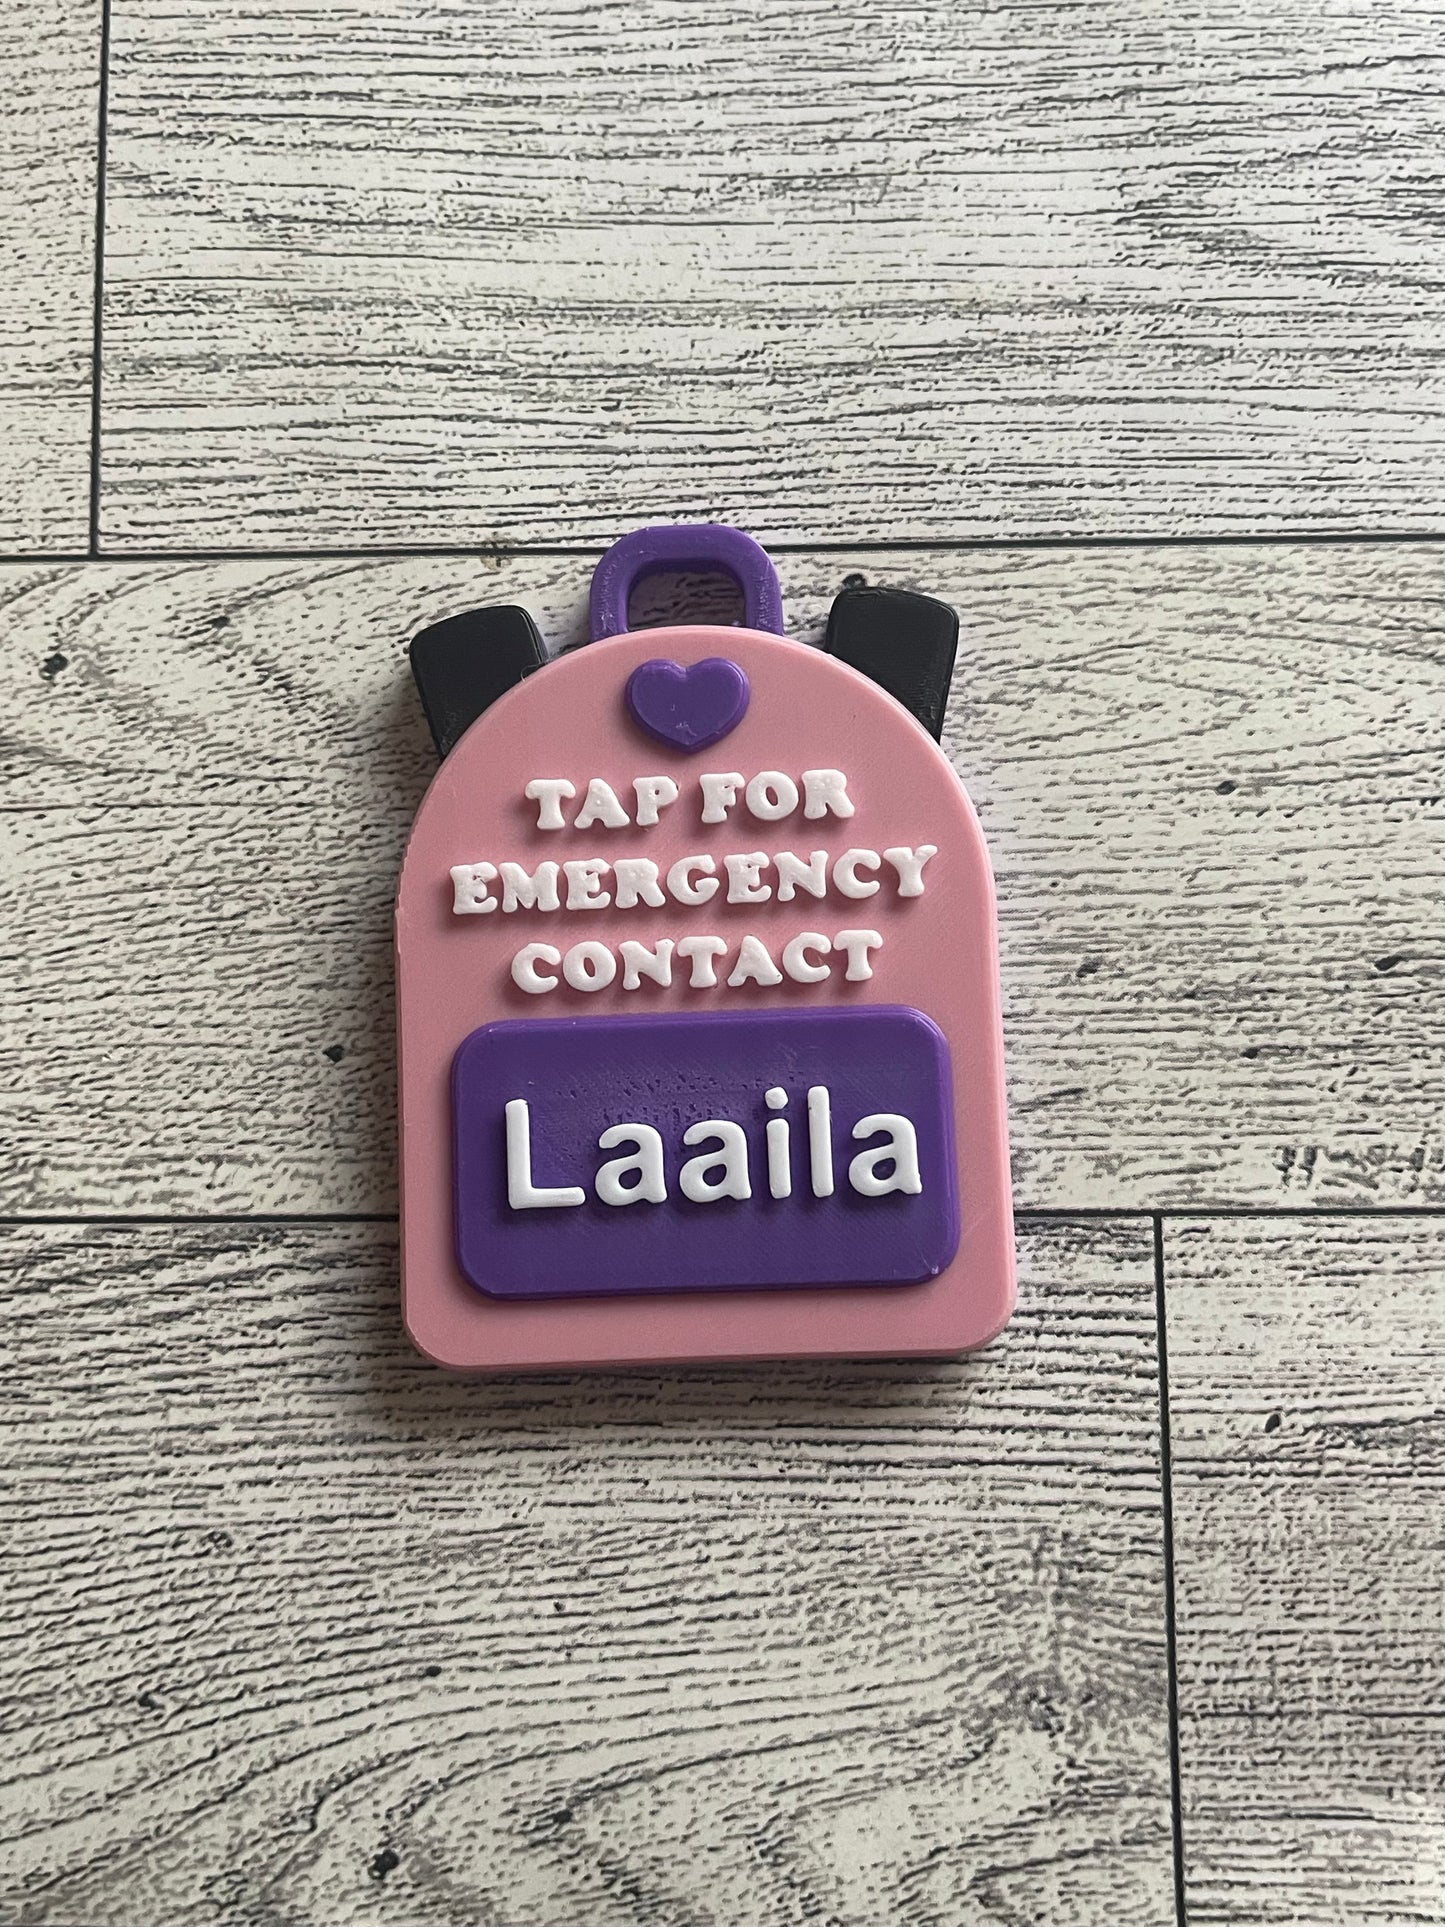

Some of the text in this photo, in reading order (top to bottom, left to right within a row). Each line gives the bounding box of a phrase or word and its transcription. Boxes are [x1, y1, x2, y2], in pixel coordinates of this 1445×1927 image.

[524, 768, 856, 830] TAP FOR
[449, 843, 939, 915] EMERGENCY
[511, 928, 884, 994] CONTACT
[504, 1085, 923, 1210] Laaila
